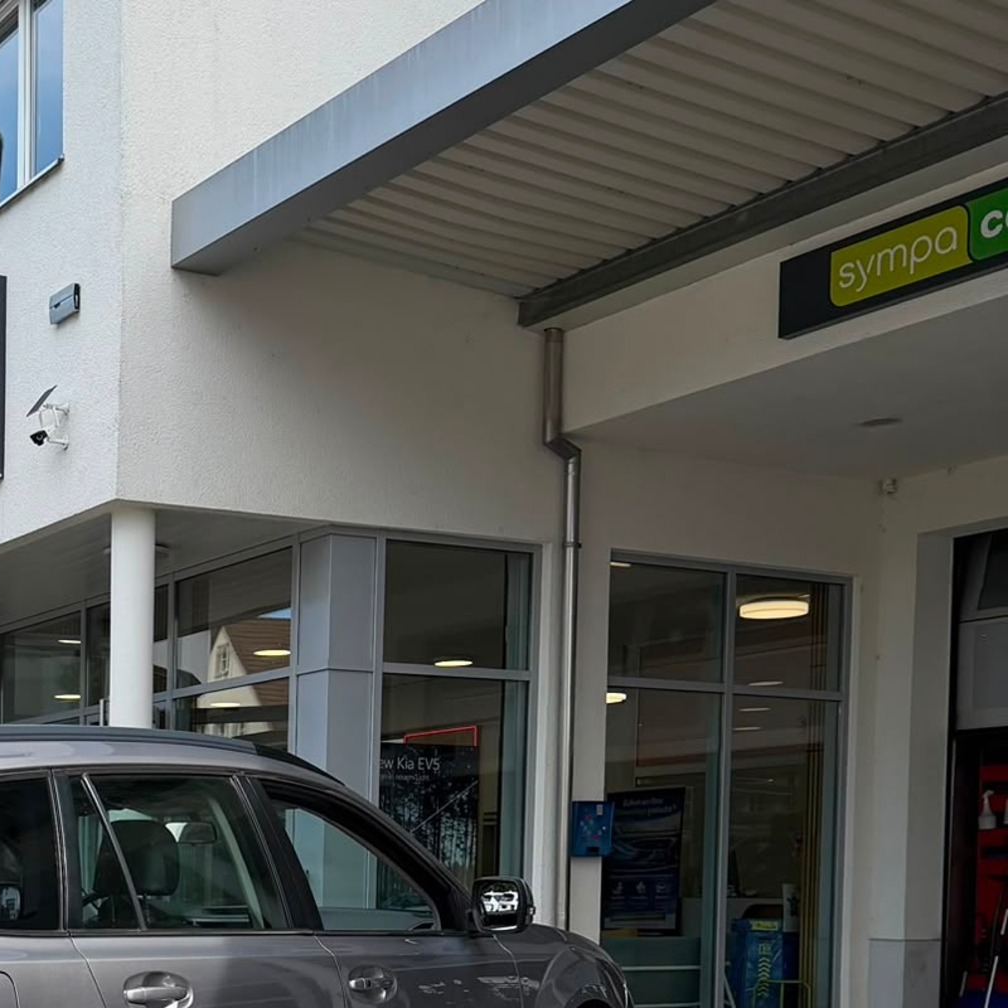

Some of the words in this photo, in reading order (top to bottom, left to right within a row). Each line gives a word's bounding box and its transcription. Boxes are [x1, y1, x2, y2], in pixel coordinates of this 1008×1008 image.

[979, 209, 1008, 238] c
[838, 226, 958, 293] sympa
[379, 758, 394, 769] ew
[396, 754, 415, 770] Kia
[417, 756, 441, 771] EV5
